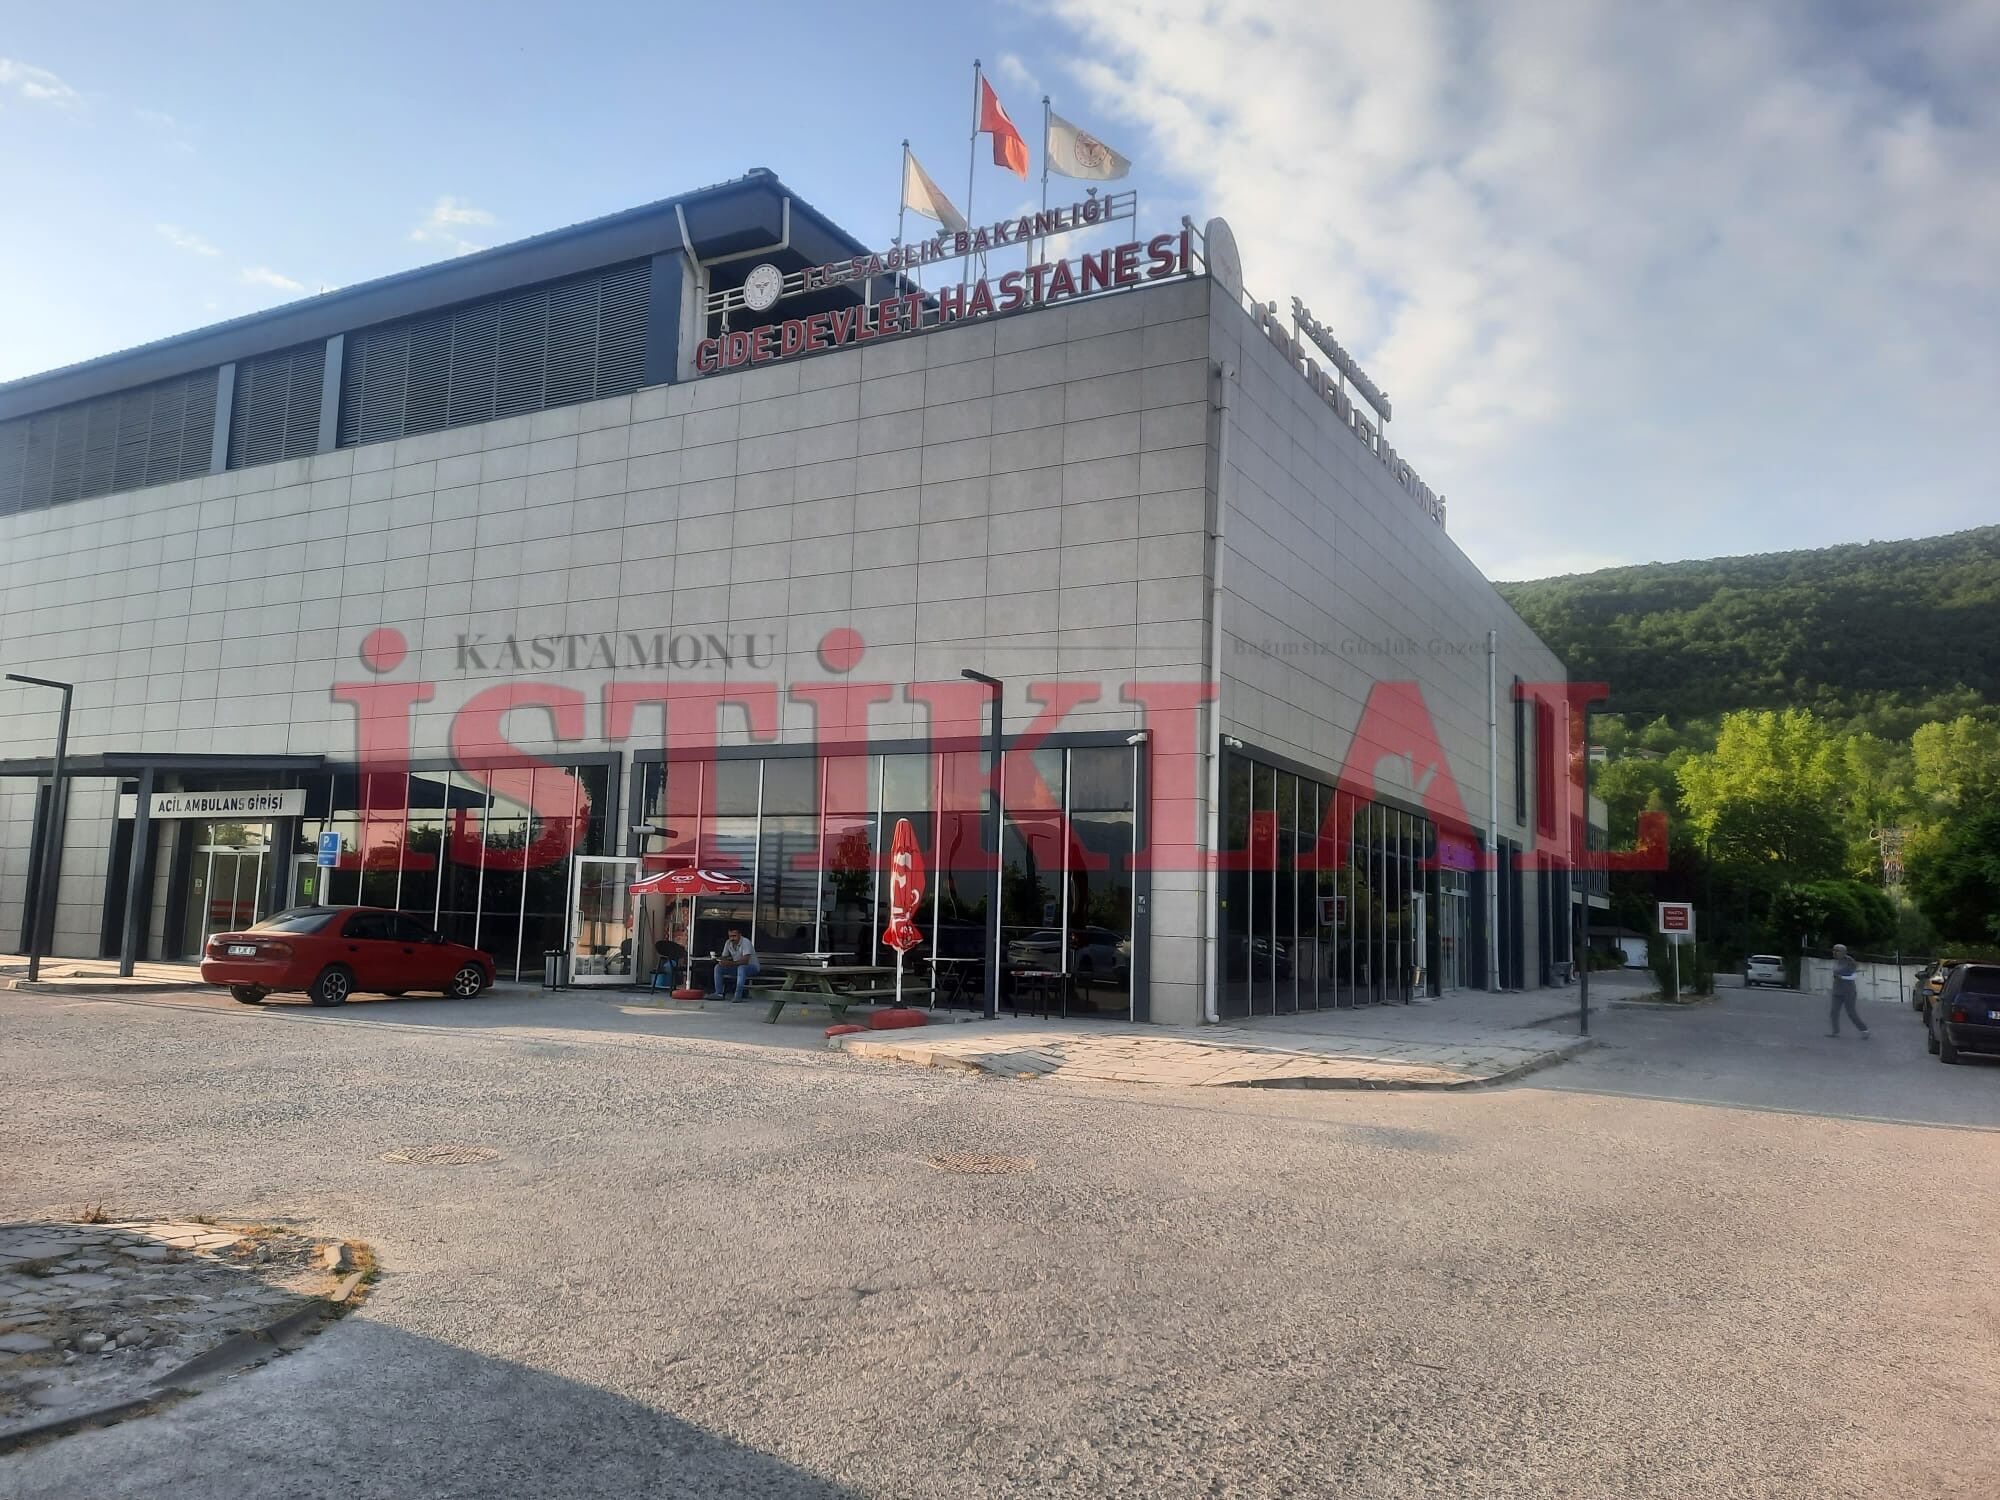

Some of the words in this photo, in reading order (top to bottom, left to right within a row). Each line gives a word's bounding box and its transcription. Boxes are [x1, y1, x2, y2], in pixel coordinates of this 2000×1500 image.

[781, 291, 926, 357] DEVLET
[938, 214, 1194, 324] HASTANESİ
[800, 263, 847, 291] T.C.
[850, 236, 946, 280] SAĞLIK
[954, 187, 1113, 255] BAKANLIĞI
[158, 796, 181, 812] ACİL
[184, 797, 245, 812] AMBULANS
[247, 793, 283, 814] GİRİŞİ
